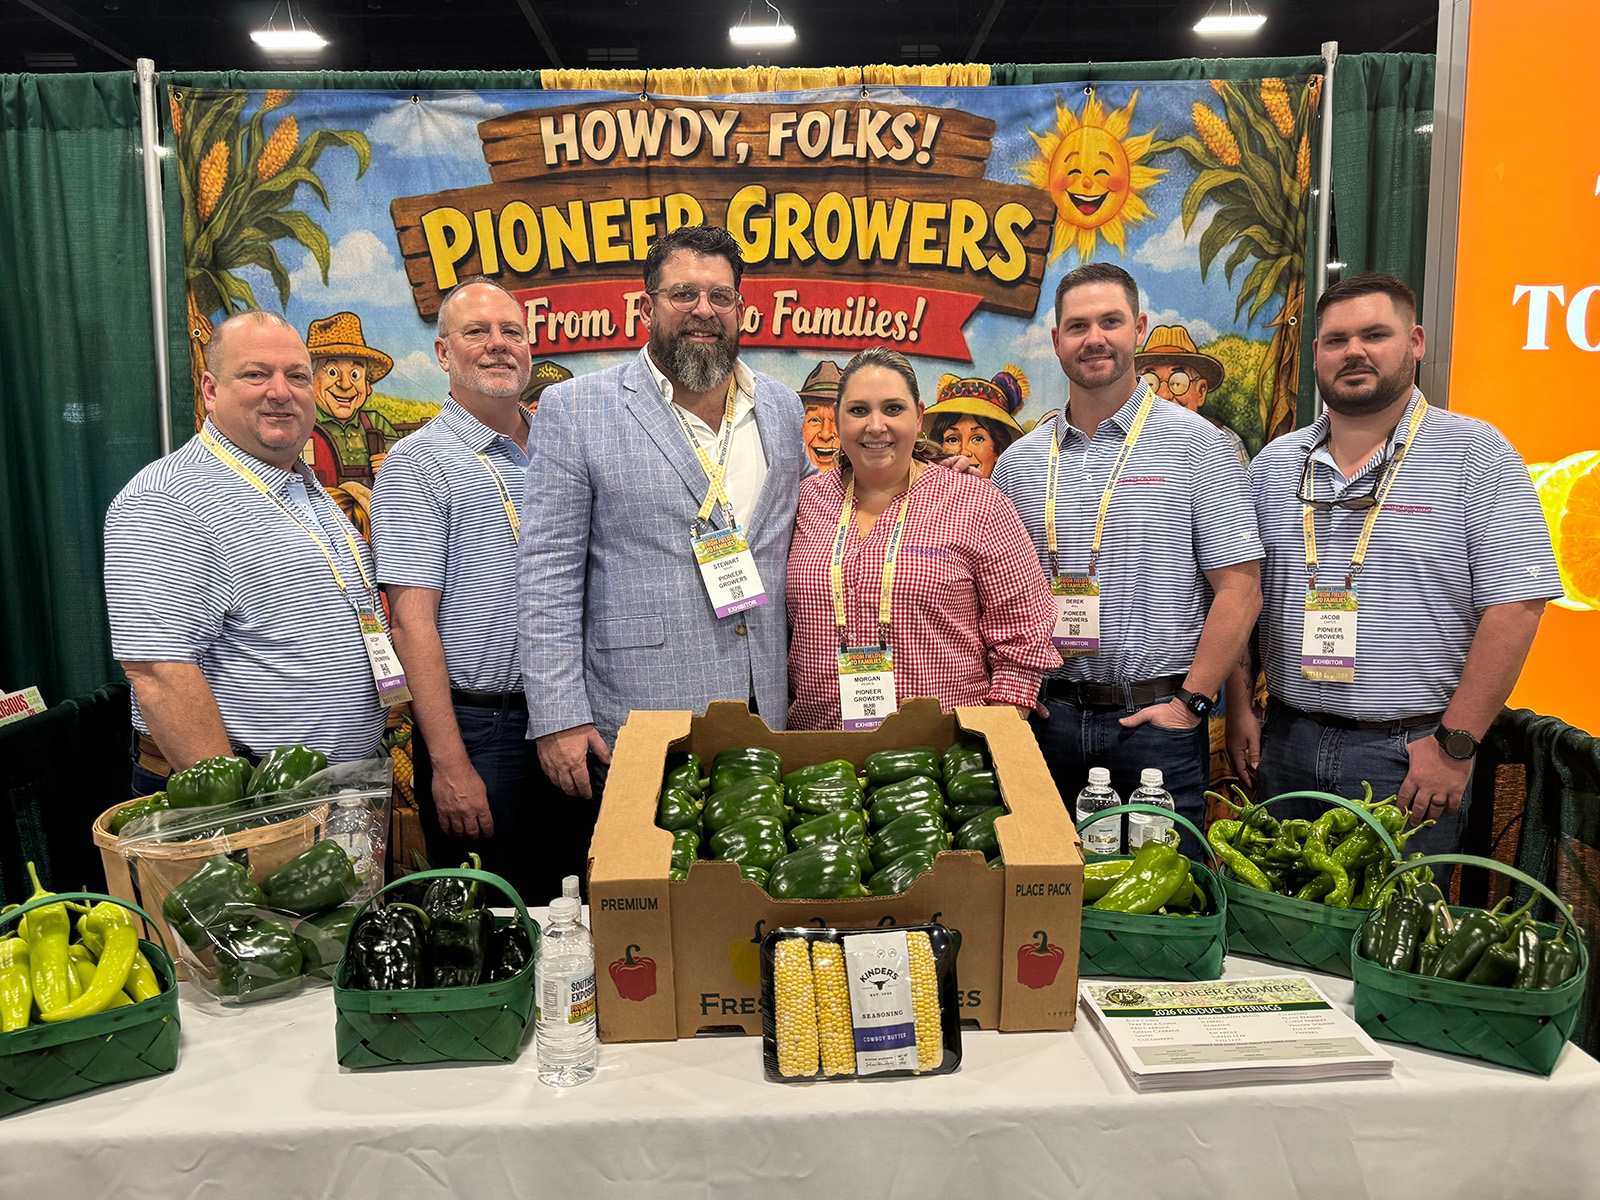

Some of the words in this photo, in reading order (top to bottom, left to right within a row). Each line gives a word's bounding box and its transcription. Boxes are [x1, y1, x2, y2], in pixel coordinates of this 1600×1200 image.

[540, 109, 748, 165] HOWDY,
[767, 106, 942, 165] FOLKS!
[725, 184, 1036, 283] GROWERS
[524, 296, 616, 345] From
[771, 288, 927, 342] Families!
[713, 557, 740, 569] STEWART
[718, 570, 744, 581] PIONEER
[718, 576, 748, 588] GROWERS
[727, 600, 758, 614] EXHIBITOR
[0, 694, 29, 720] ICIOUS
[1016, 883, 1044, 896] PLACE
[1048, 883, 1072, 896] PACK
[601, 898, 658, 911] PREMIUM
[1118, 992, 1134, 1000] 75
[1158, 987, 1223, 998] PIONEER
[1226, 984, 1301, 996] GROWERS
[862, 1010, 904, 1019] SEASONING
[1152, 1008, 1176, 1016] 2026
[1178, 1006, 1226, 1015] PRODUCT
[1228, 1004, 1282, 1013] OFFERINGS
[887, 1032, 906, 1040] BUTTER
